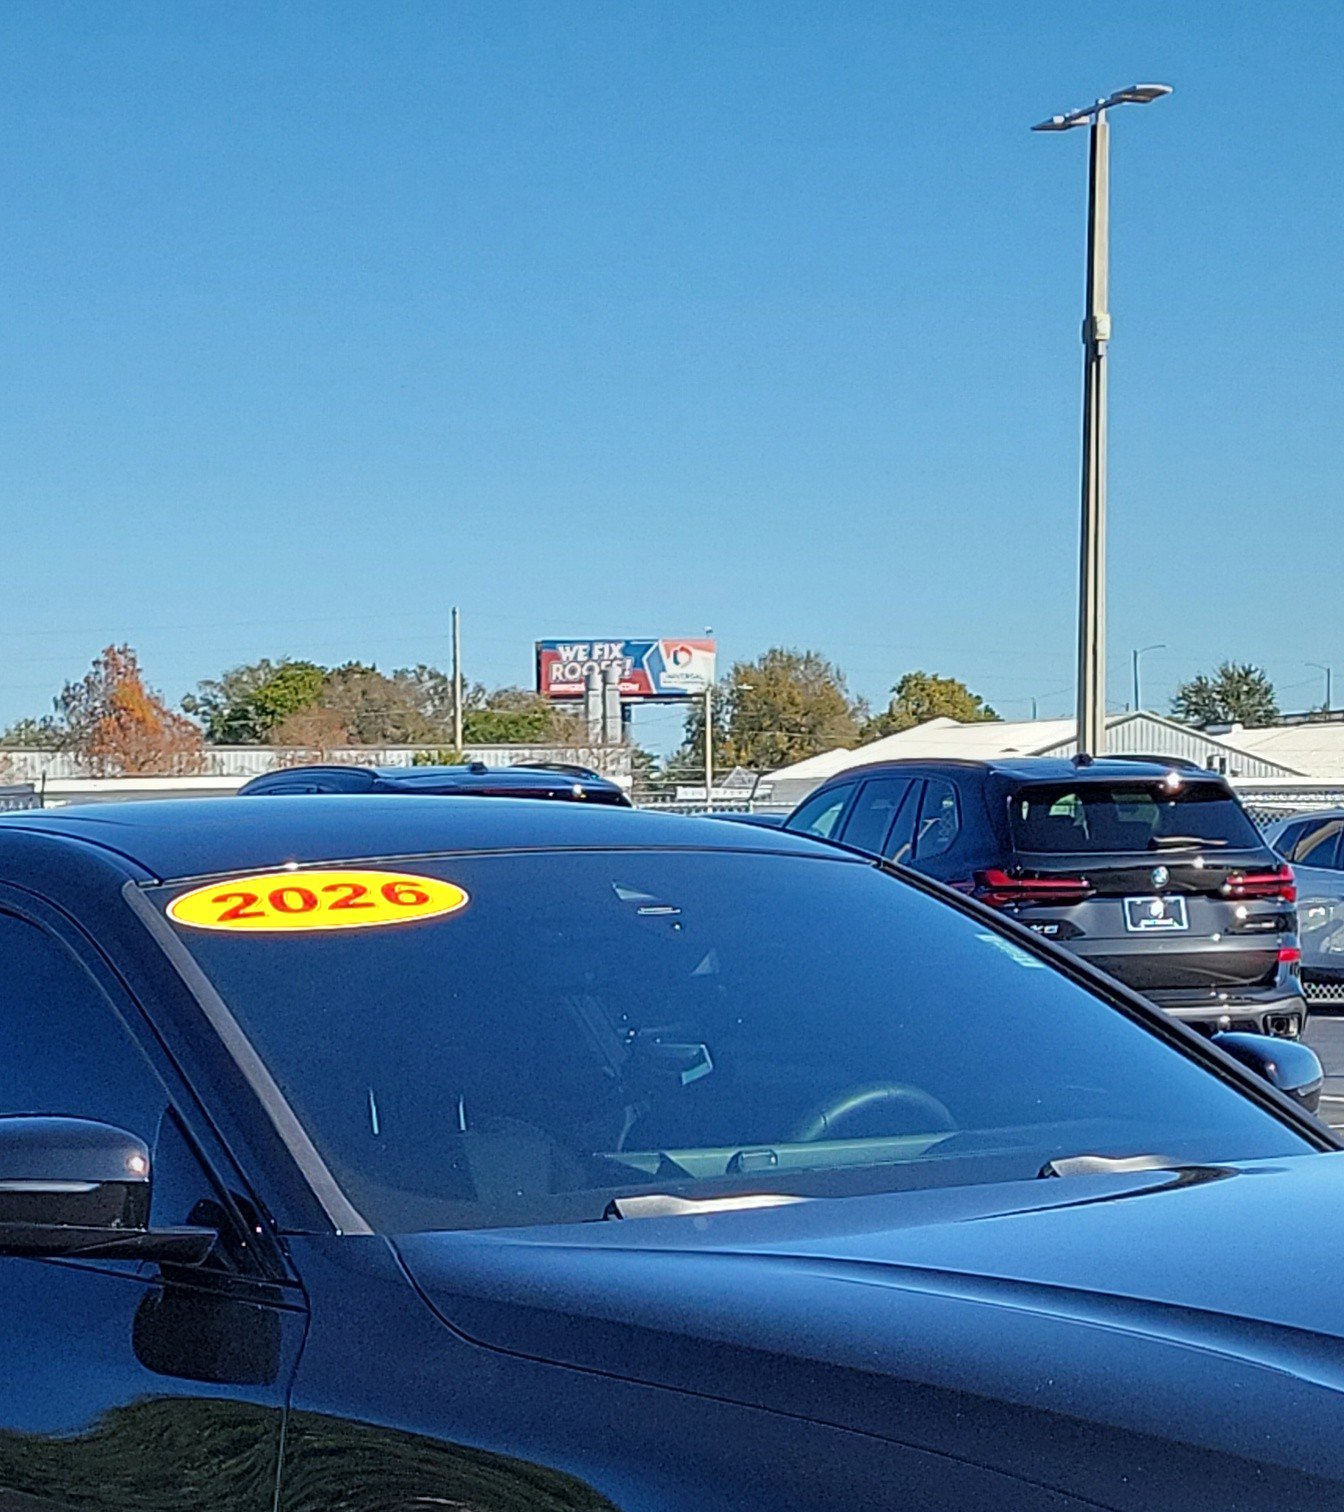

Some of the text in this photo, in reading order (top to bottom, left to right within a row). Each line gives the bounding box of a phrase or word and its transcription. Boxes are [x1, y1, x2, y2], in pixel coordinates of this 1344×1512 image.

[557, 642, 625, 662] WE FIX
[211, 881, 430, 922] 2026
